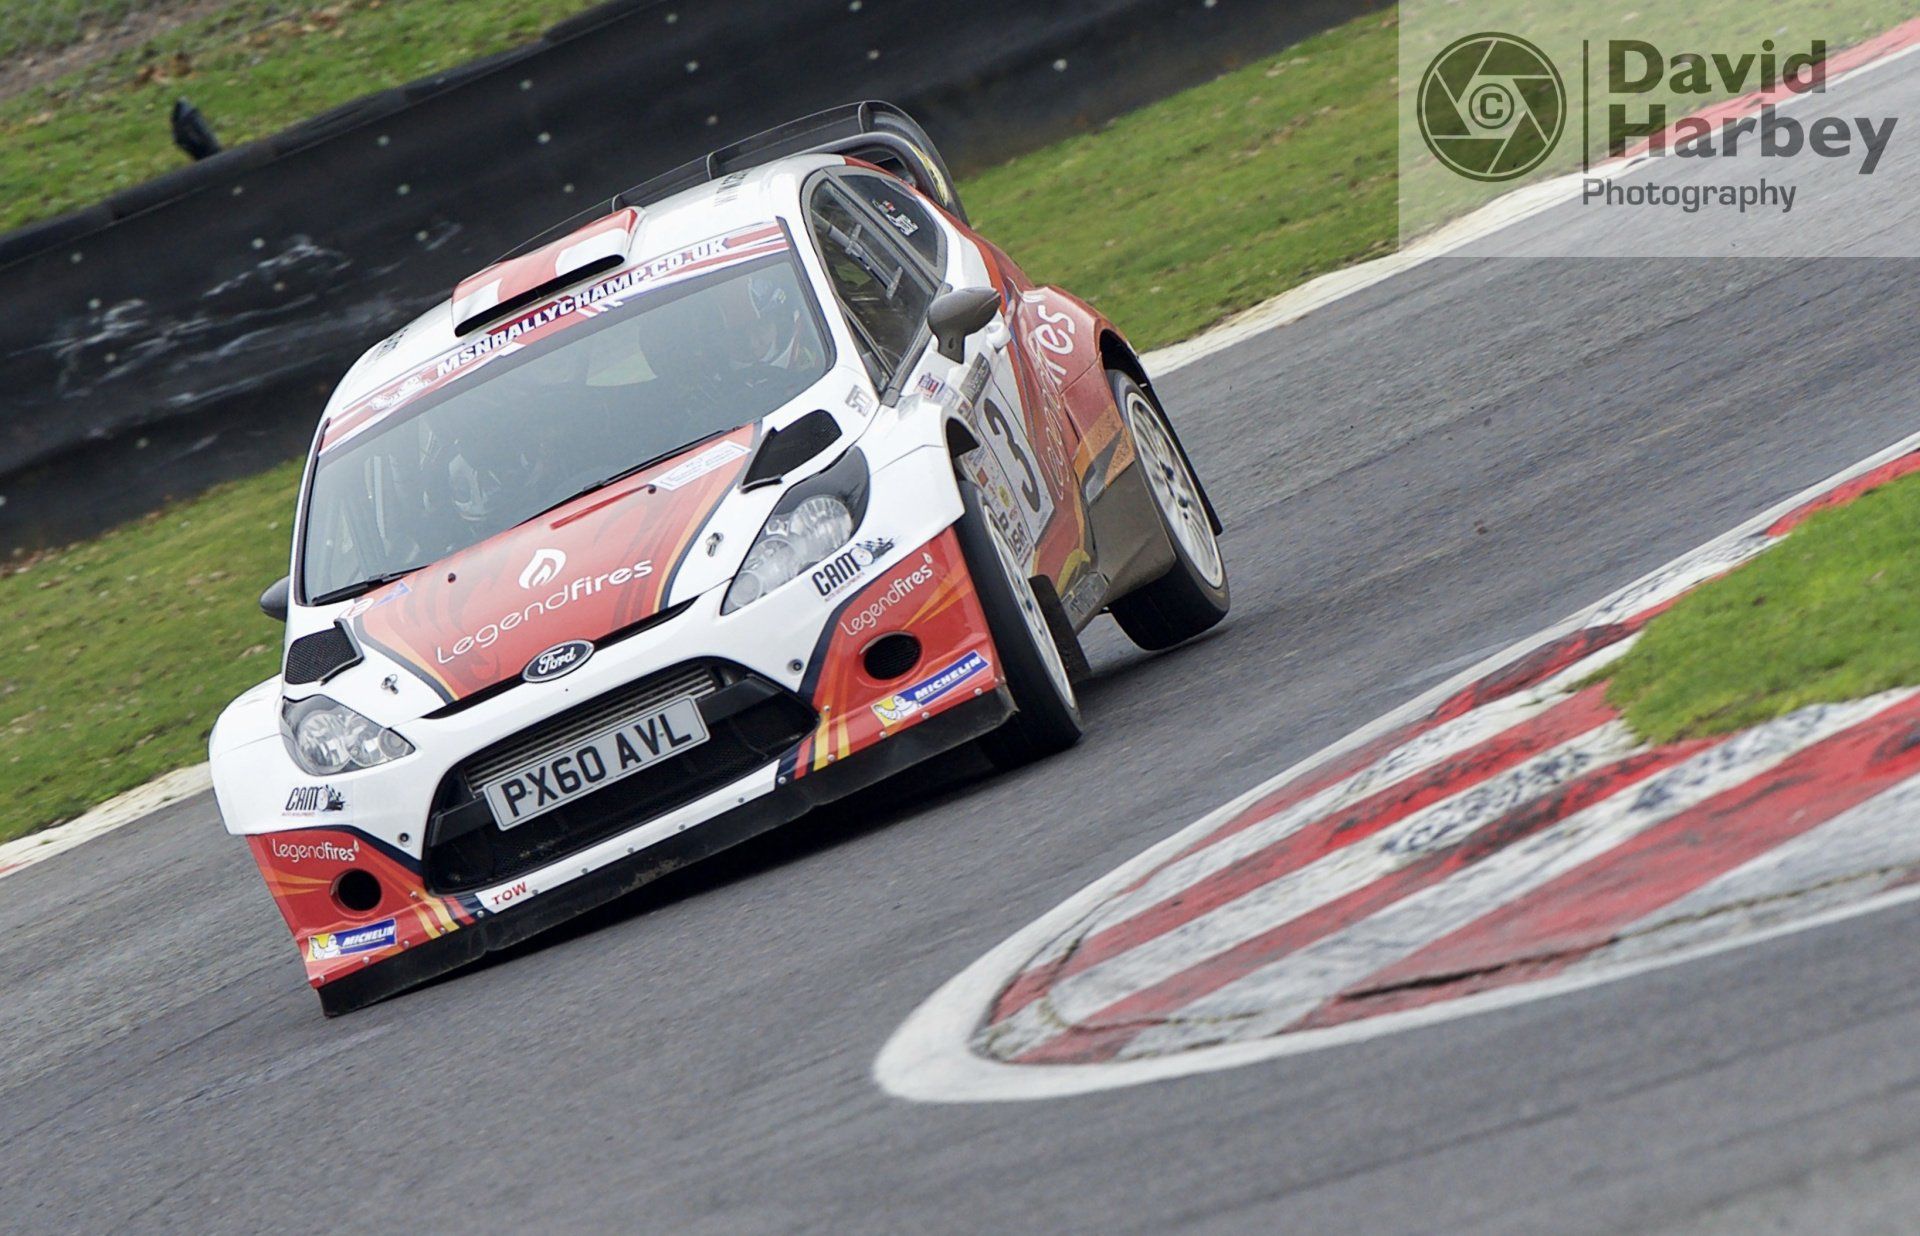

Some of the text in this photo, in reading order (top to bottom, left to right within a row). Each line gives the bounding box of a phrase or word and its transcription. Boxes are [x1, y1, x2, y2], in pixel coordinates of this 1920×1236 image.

[435, 237, 730, 379] MSNRALLYCHAMP.CO.UK
[983, 398, 1041, 513] 3
[537, 646, 577, 675] Ford
[914, 656, 982, 700] MICHELIN
[500, 713, 692, 818] PX60 AVL
[491, 881, 528, 905] TOW
[342, 924, 396, 948] MICHELIN
